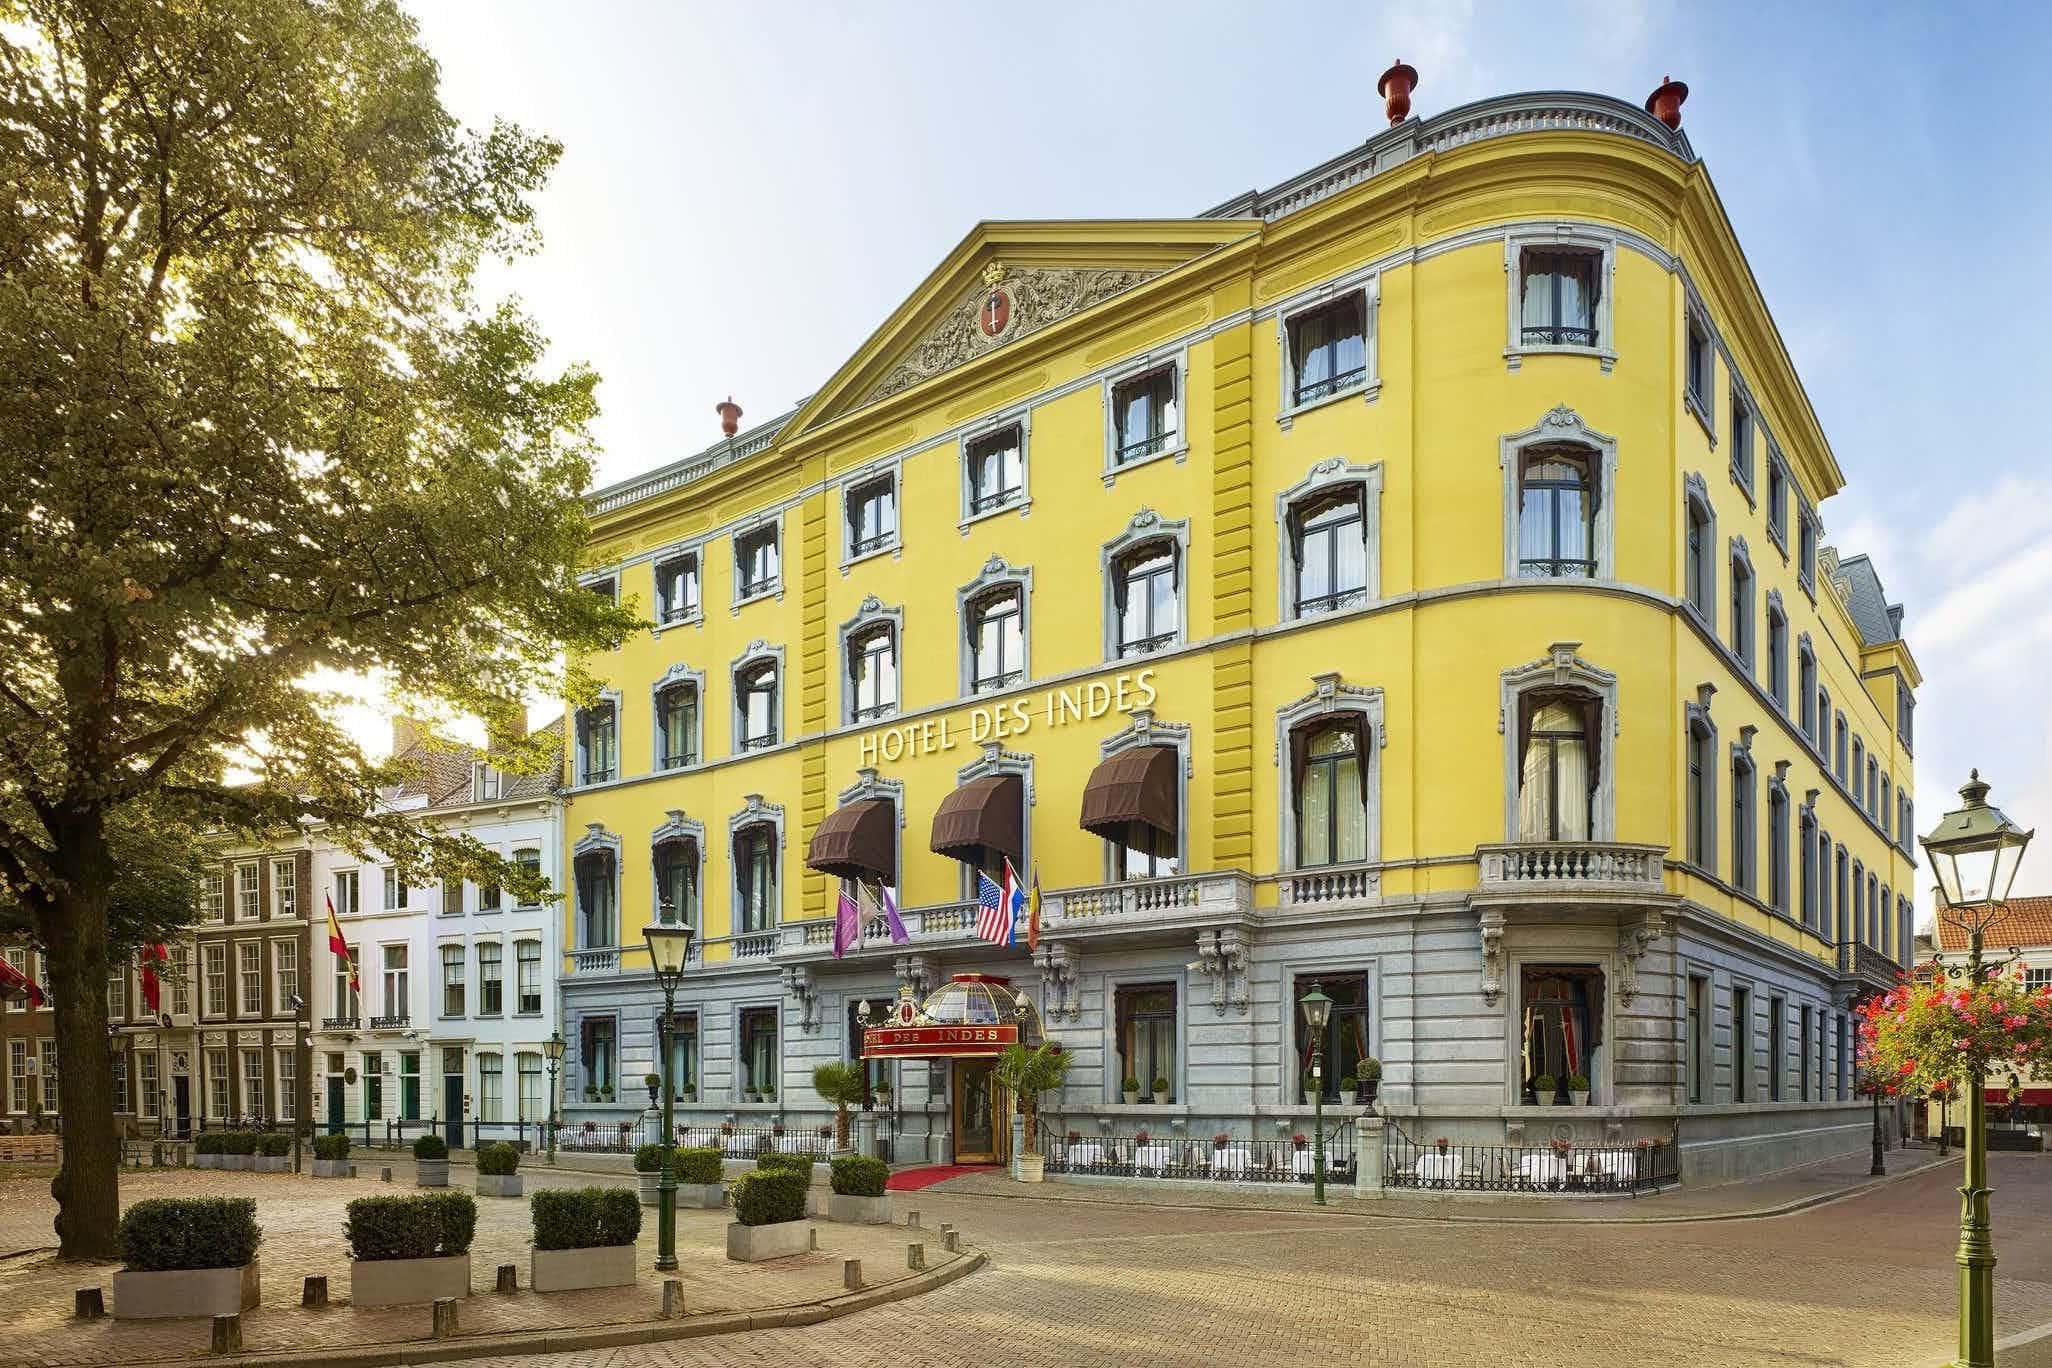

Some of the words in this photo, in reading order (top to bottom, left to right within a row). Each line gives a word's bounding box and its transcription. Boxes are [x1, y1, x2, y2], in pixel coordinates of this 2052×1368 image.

[860, 718, 955, 766] HOTEL
[971, 699, 1031, 742] DES
[1047, 670, 1157, 726] INDES
[894, 1033, 919, 1043] DES
[939, 1030, 998, 1041] INDES
